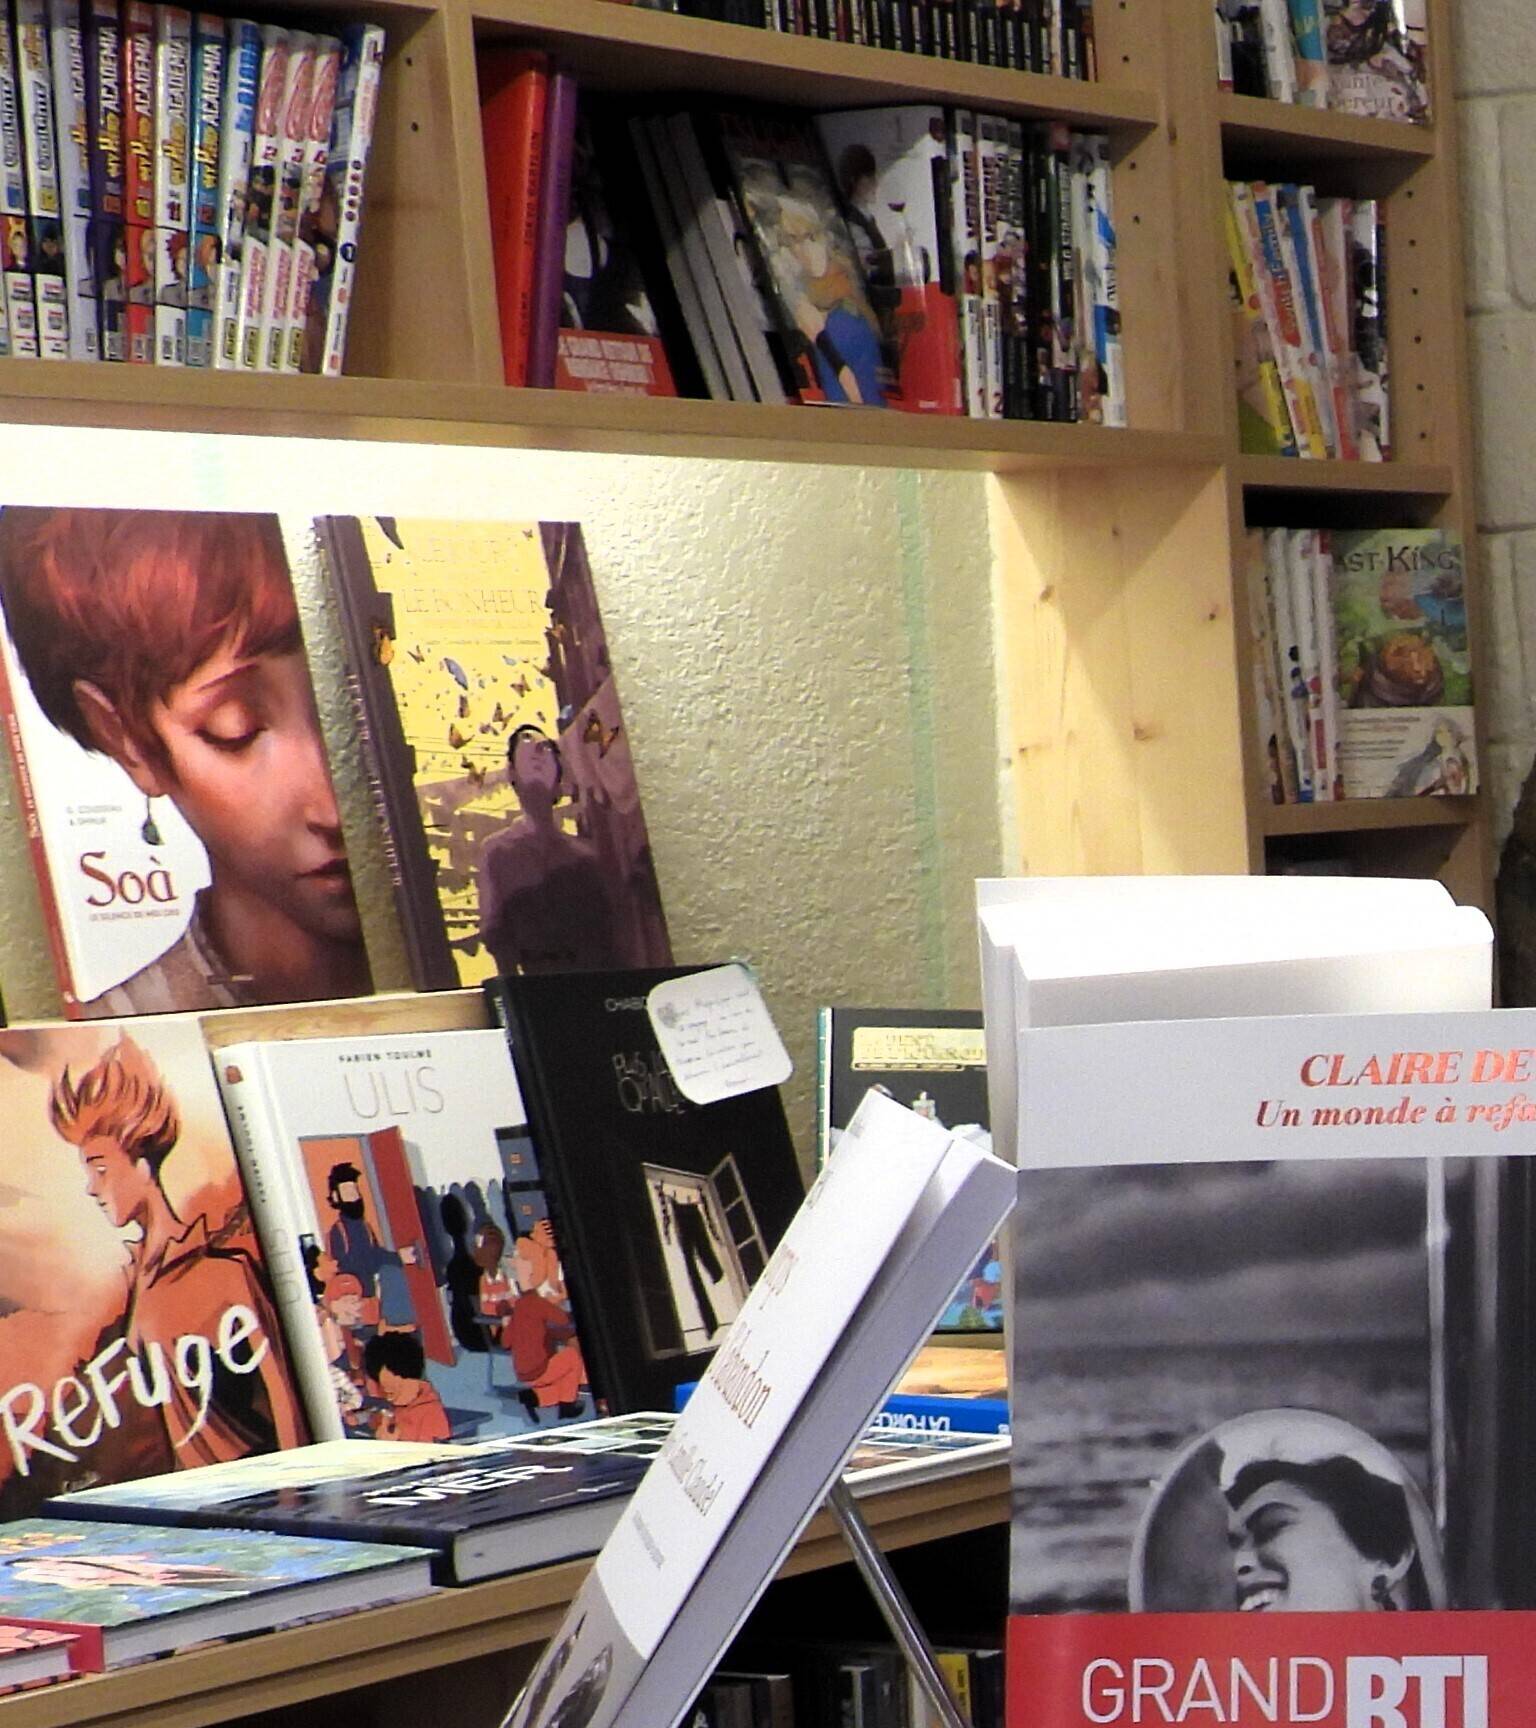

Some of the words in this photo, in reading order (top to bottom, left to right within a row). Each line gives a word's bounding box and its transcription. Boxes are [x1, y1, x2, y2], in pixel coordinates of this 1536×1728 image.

[202, 44, 222, 127] ACADEMIA
[80, 851, 179, 907] Soà
[346, 1066, 446, 1120] ULIS
[1299, 1050, 1464, 1089] CLAIRE
[1254, 1100, 1304, 1128] Un
[1312, 1096, 1428, 1127] monde
[1435, 1095, 1457, 1126] à
[1082, 1656, 1335, 1724] GRAND
